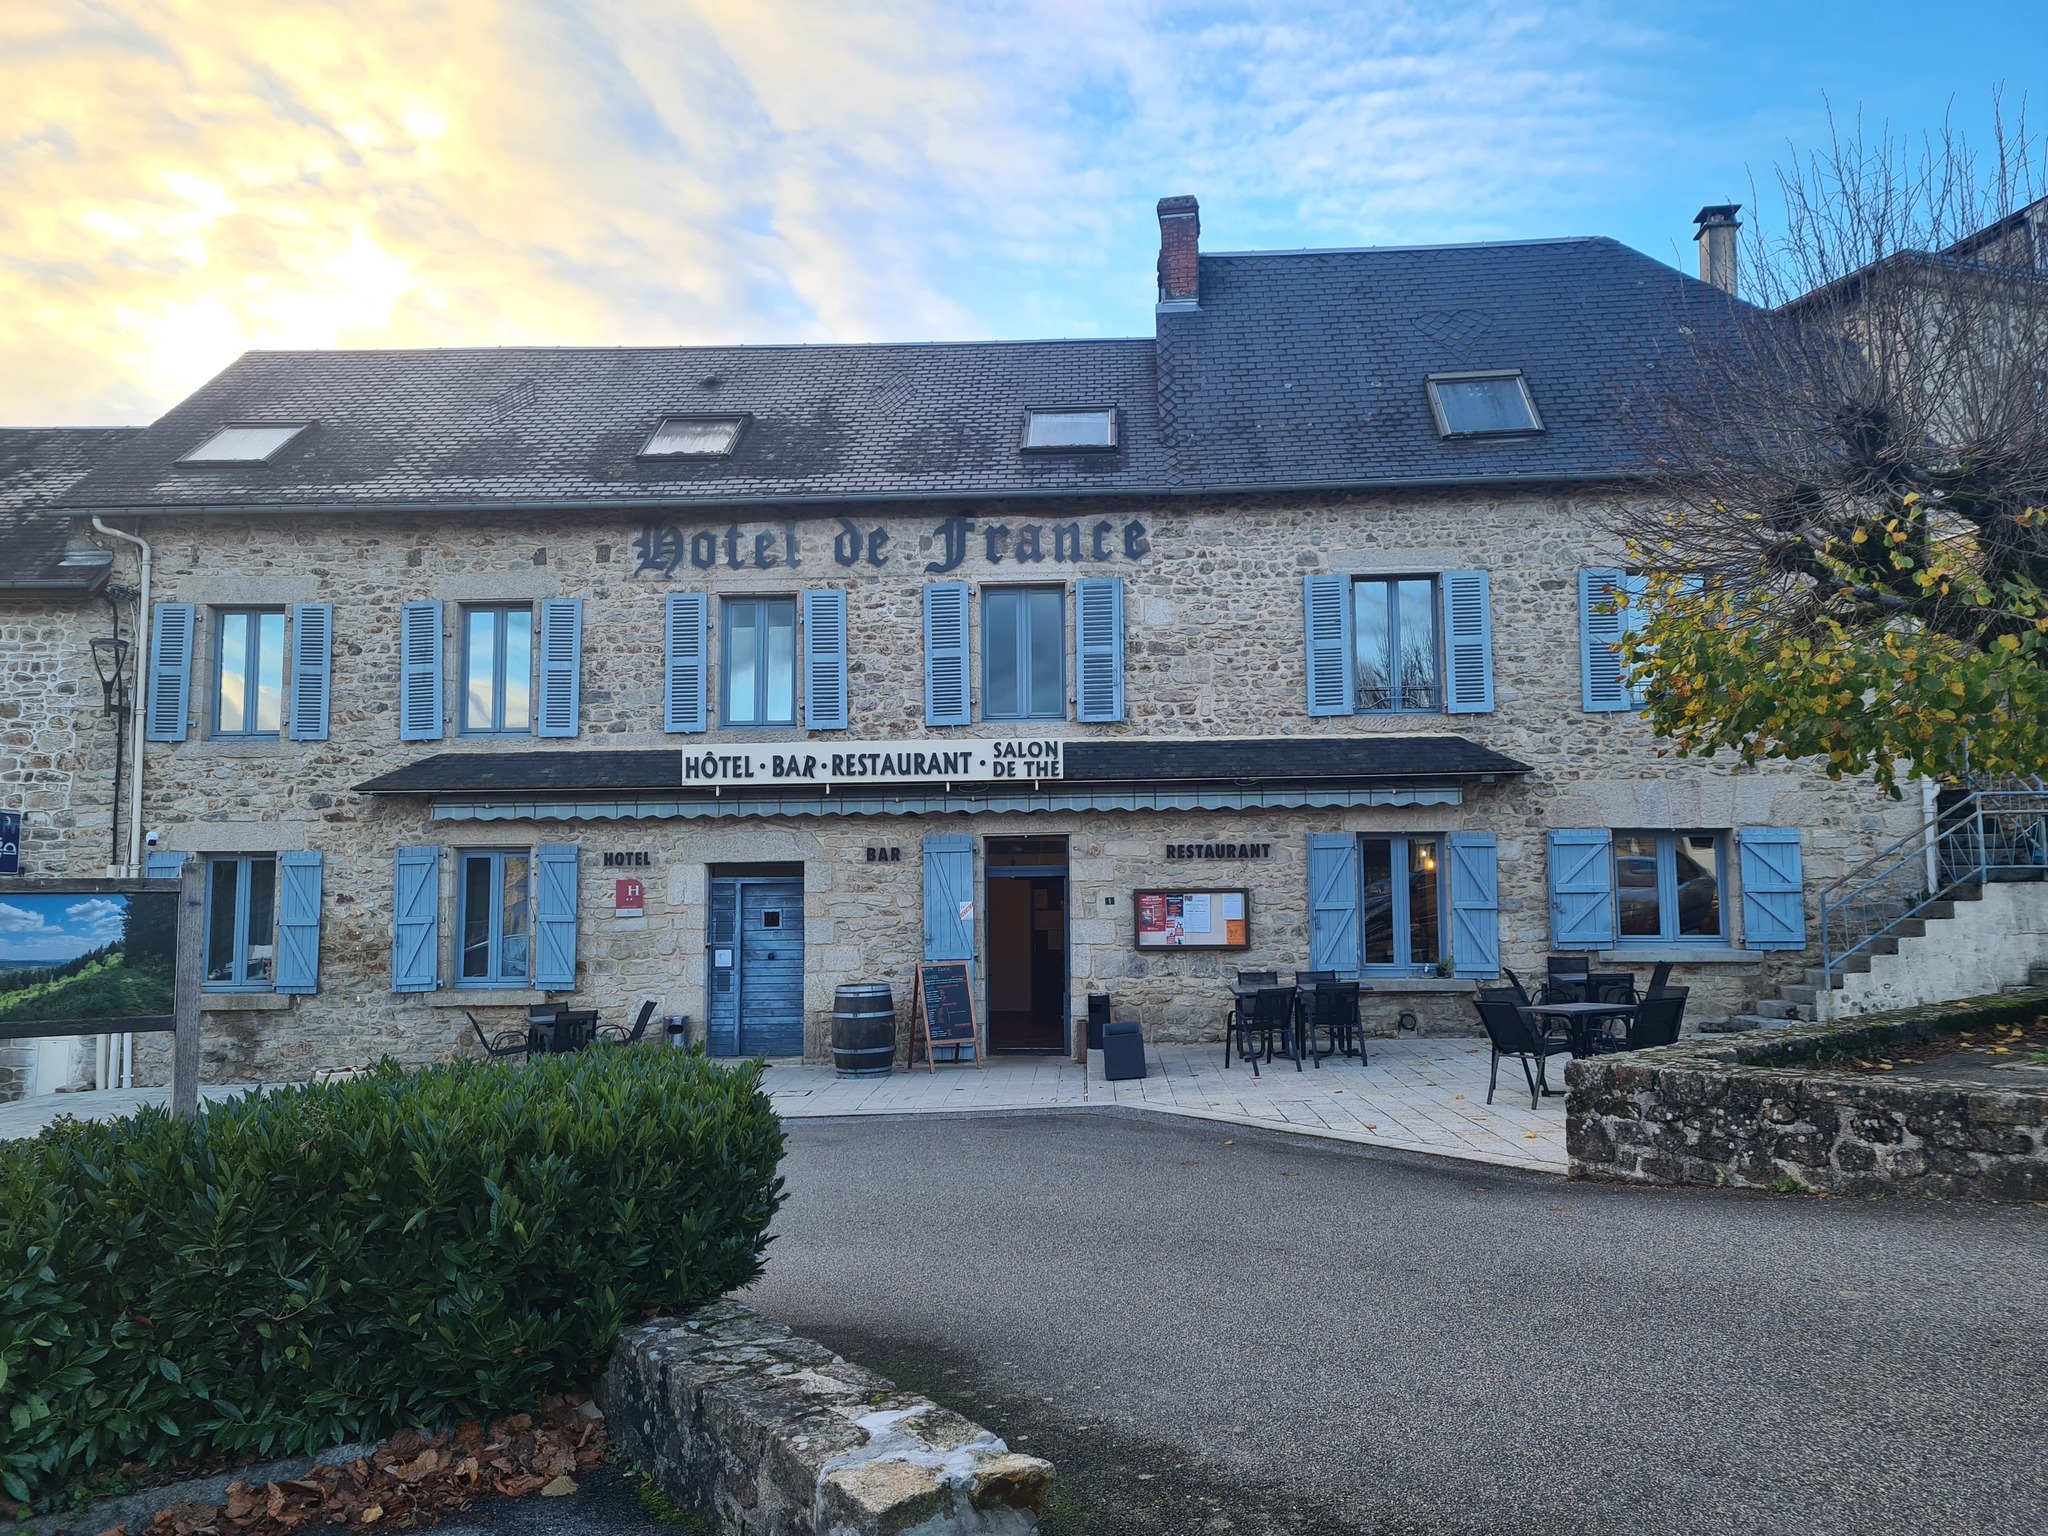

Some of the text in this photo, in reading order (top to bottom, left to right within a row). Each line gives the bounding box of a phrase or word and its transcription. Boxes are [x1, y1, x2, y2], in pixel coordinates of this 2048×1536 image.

[632, 516, 1151, 579] Hotel de France
[993, 741, 1058, 759] SALON
[685, 751, 972, 779] HÔTEL BAR RESTAURANT
[993, 761, 1016, 777] DE
[603, 852, 650, 866] HOTEL
[866, 847, 901, 861] BAR
[1166, 844, 1270, 859] RESTAURANT
[628, 885, 640, 896] H
